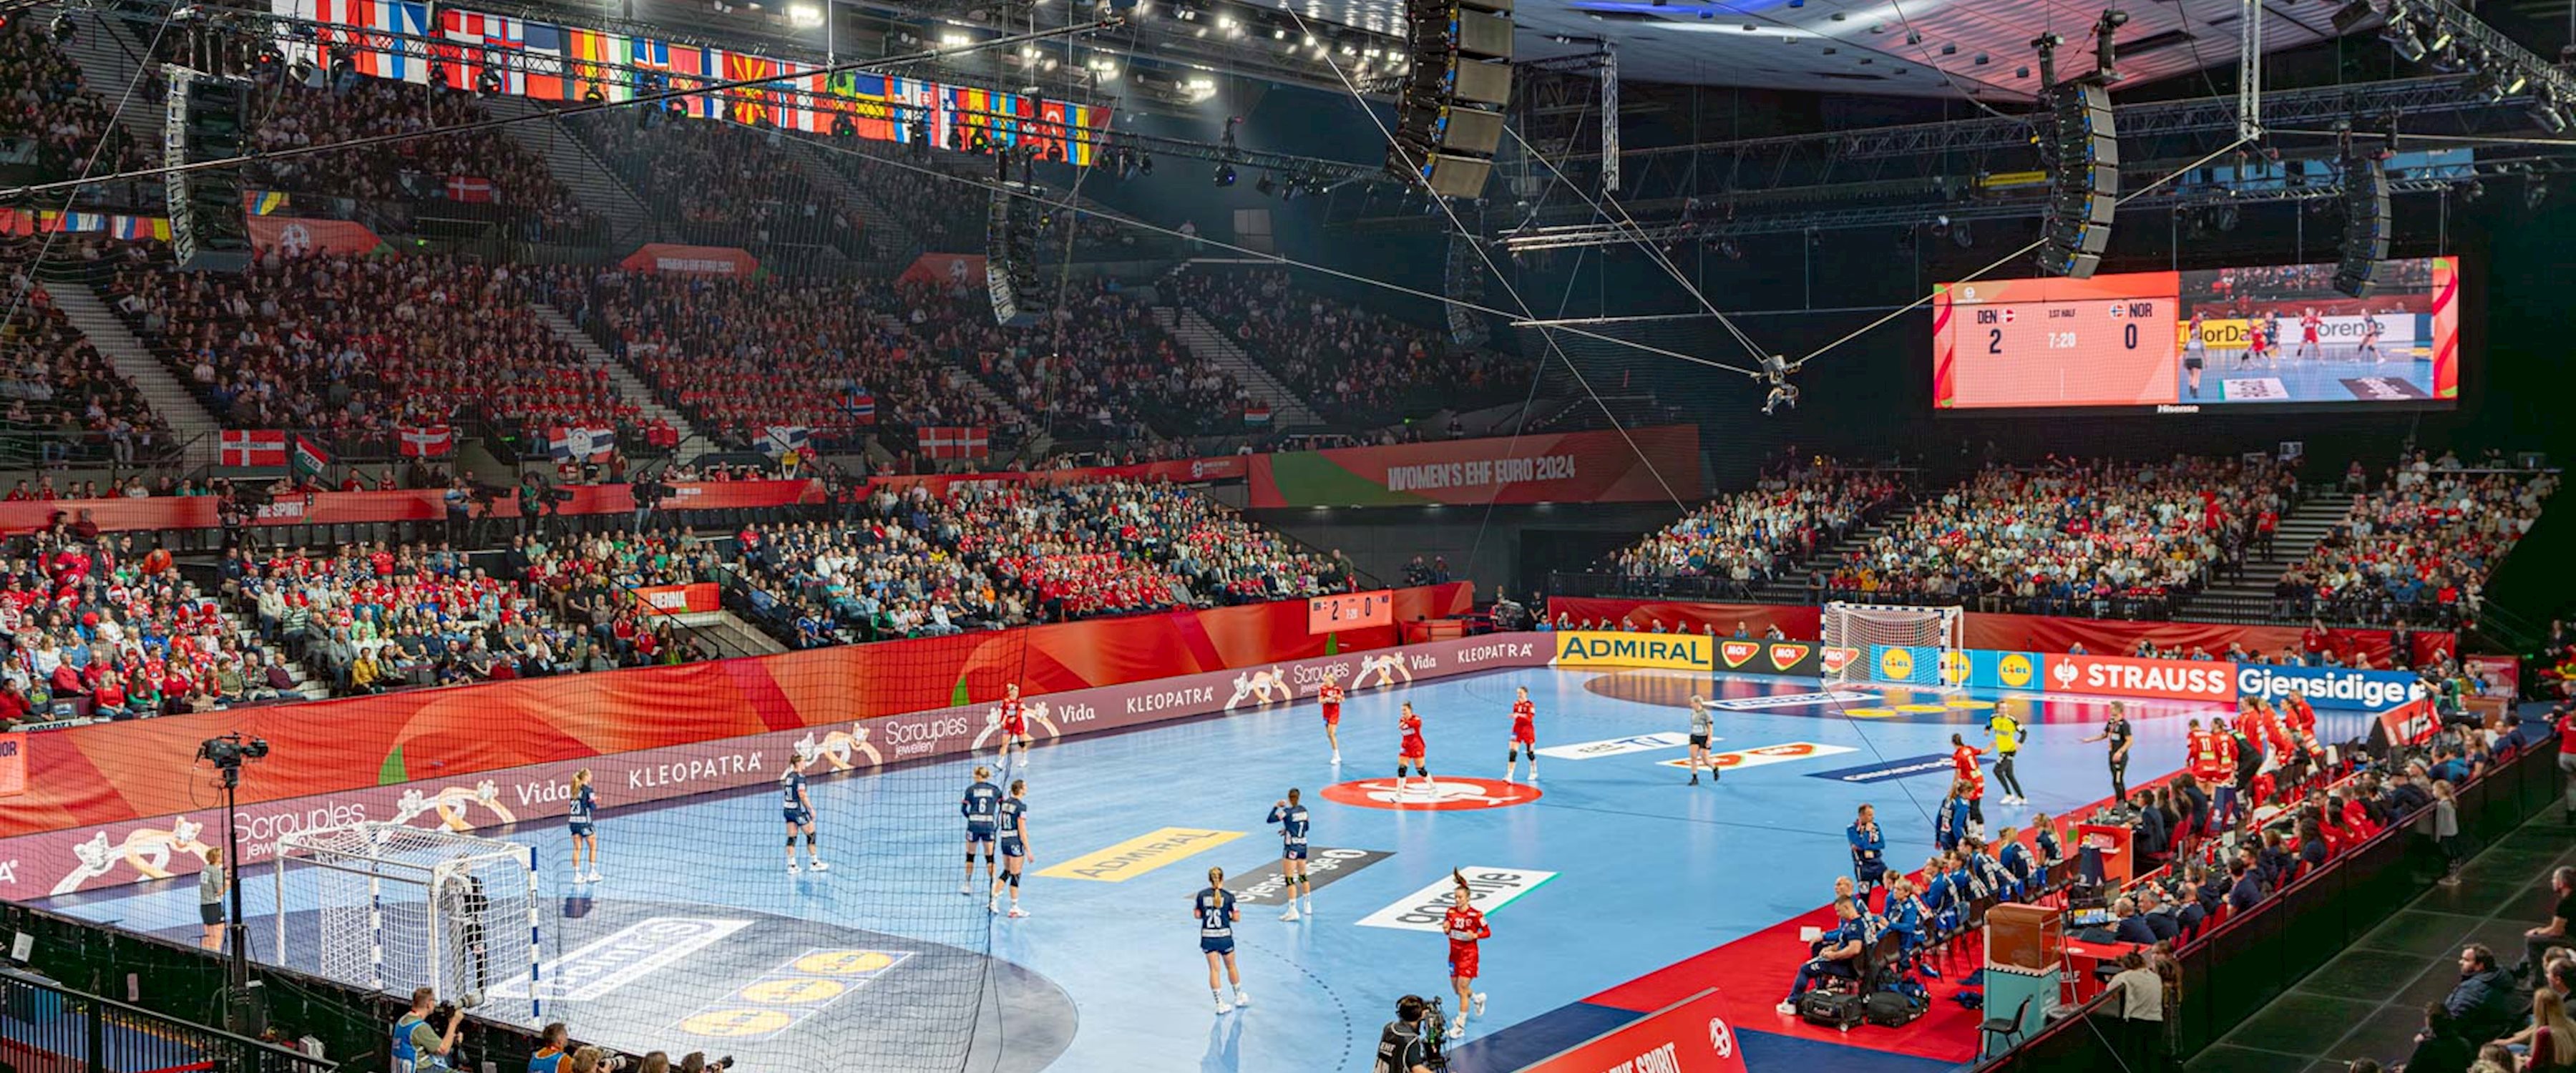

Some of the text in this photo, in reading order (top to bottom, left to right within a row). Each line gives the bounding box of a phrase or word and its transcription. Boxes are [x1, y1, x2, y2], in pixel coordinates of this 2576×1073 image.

[1977, 310, 1997, 324] DEN
[2129, 303, 2152, 318] NOR
[1989, 328, 2002, 354] 2
[2048, 332, 2076, 349] 7:20
[2124, 323, 2137, 349] 0
[1387, 454, 1575, 491] WOMEN'S EHF EURO 2024
[272, 501, 305, 517] SPIRIT
[1332, 600, 1338, 620] 2
[1365, 597, 1371, 617] 0
[1561, 637, 1709, 666] ADMIRAL
[1726, 645, 1747, 655] MOL
[1775, 647, 1796, 658] MOL
[1825, 650, 1843, 660] MO
[1410, 654, 1436, 670] Vida
[2087, 665, 2227, 694] STRAUSS
[2238, 668, 2406, 707] Gjensidige
[1059, 703, 1096, 724] Vida
[885, 715, 967, 745] Scrouples
[894, 740, 936, 759] jewellery
[2200, 737, 2212, 752] 11
[515, 780, 571, 806] Vida
[978, 798, 987, 813] 6
[233, 800, 366, 843] Scrouples
[1073, 830, 1220, 878] ADMIRAL
[1206, 908, 1223, 928] 26
[1454, 917, 1465, 929] 33
